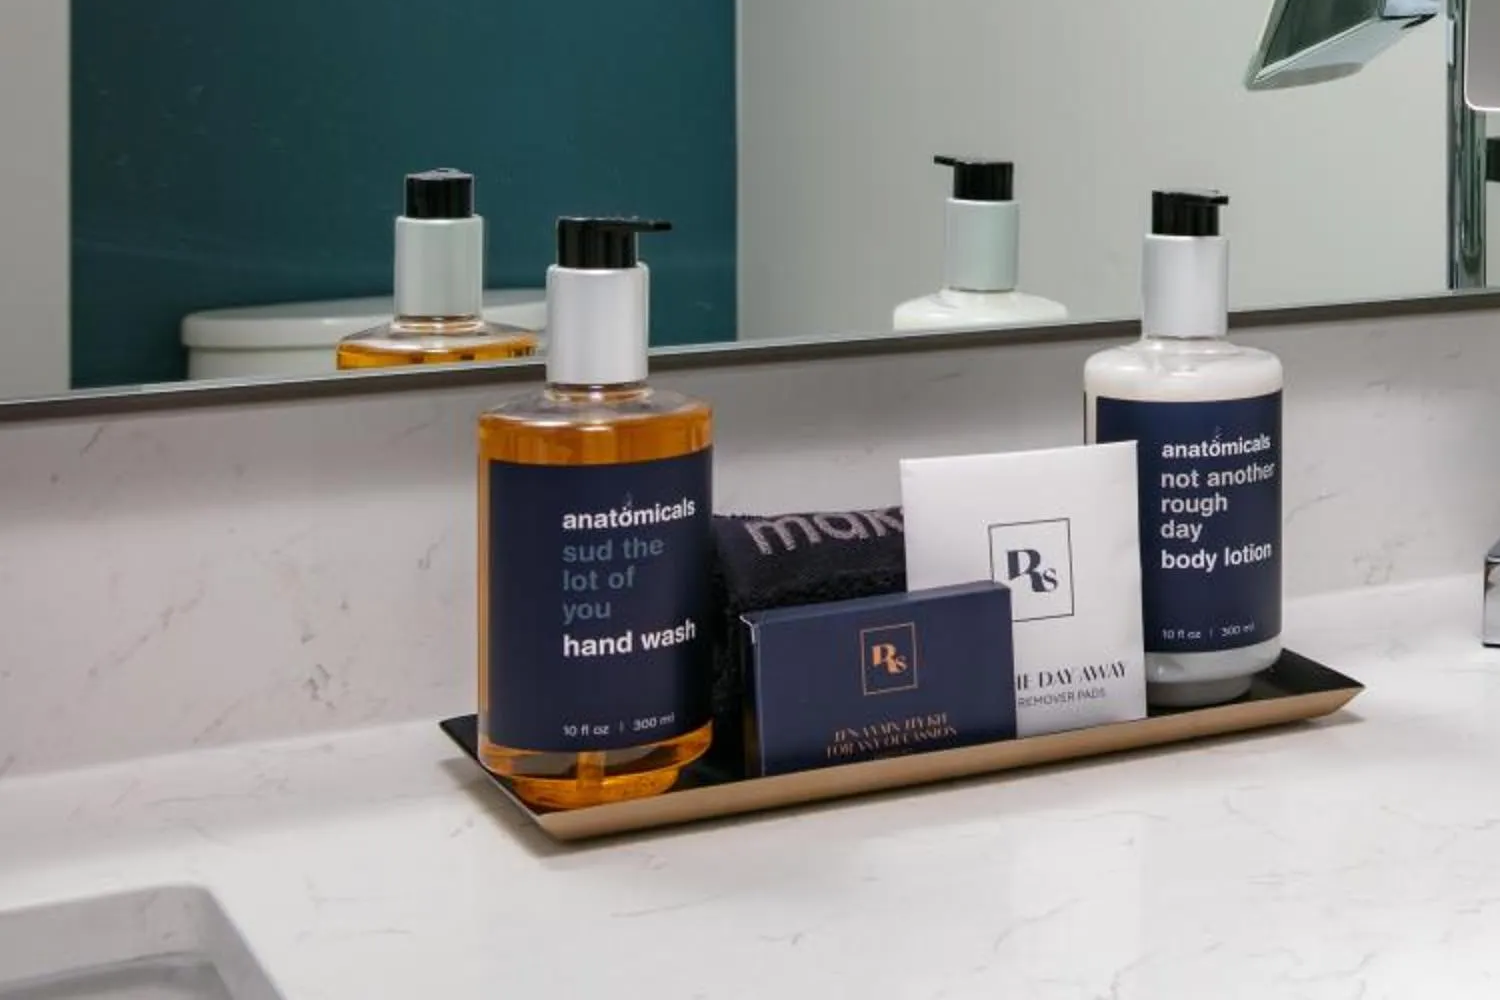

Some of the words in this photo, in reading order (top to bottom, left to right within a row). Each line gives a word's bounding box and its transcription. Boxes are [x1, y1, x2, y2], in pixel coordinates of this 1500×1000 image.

[1161, 469, 1200, 489] not
[1206, 462, 1276, 488] another
[1161, 492, 1228, 517] rough
[1160, 519, 1203, 543] day
[562, 539, 613, 563] sud
[622, 536, 665, 560] the
[1161, 548, 1218, 573] body
[1223, 542, 1272, 567] lotion
[563, 569, 599, 592] lot
[607, 564, 636, 590] of
[562, 601, 612, 626] you
[562, 629, 634, 657] hand
[640, 617, 697, 651] wash
[1162, 628, 1175, 640] 10
[1039, 668, 1073, 688] DAY
[1081, 660, 1128, 682] AWAY
[563, 725, 578, 737] 10
[580, 723, 590, 736] fl
[593, 725, 610, 735] oz
[632, 716, 657, 731] 300
